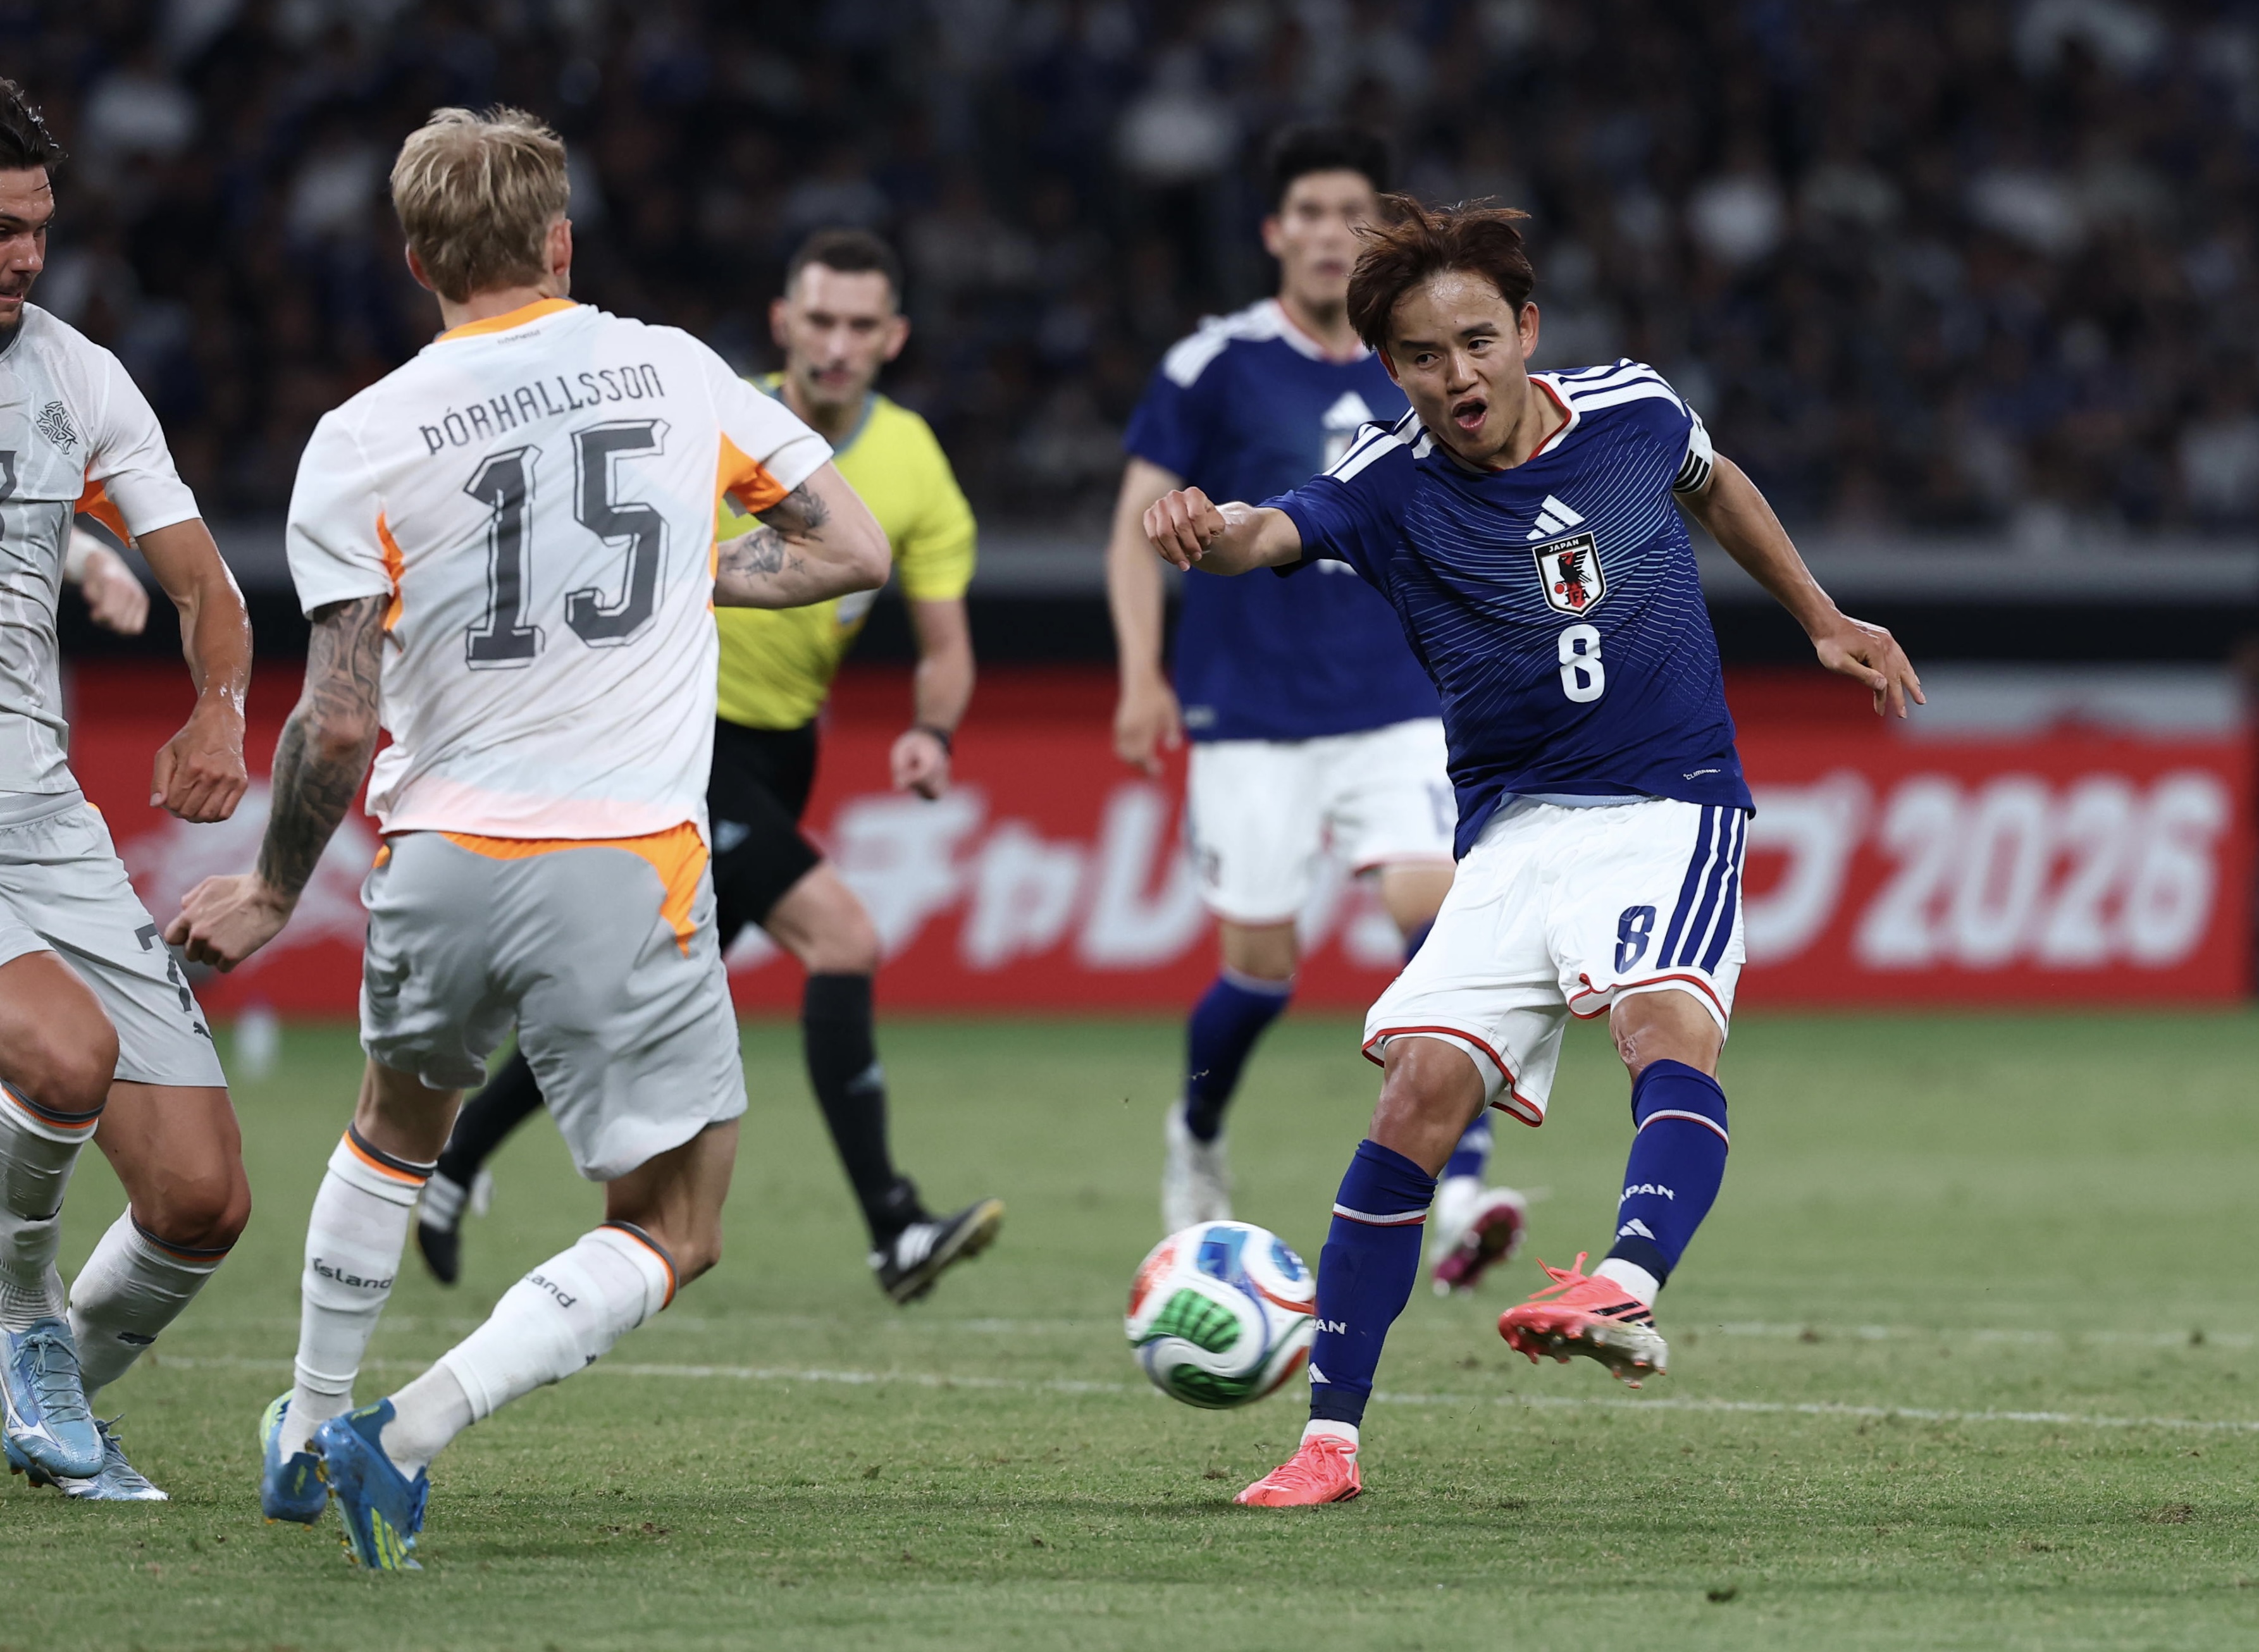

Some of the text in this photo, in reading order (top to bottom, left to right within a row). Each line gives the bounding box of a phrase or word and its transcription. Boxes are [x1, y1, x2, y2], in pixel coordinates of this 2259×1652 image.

[463, 418, 671, 671] 15
[1548, 538, 1580, 553] JAPAN
[1564, 589, 1592, 605] JFA
[1557, 624, 1606, 703] 8
[1854, 772, 2229, 969] 2026
[1614, 905, 1657, 975] 8
